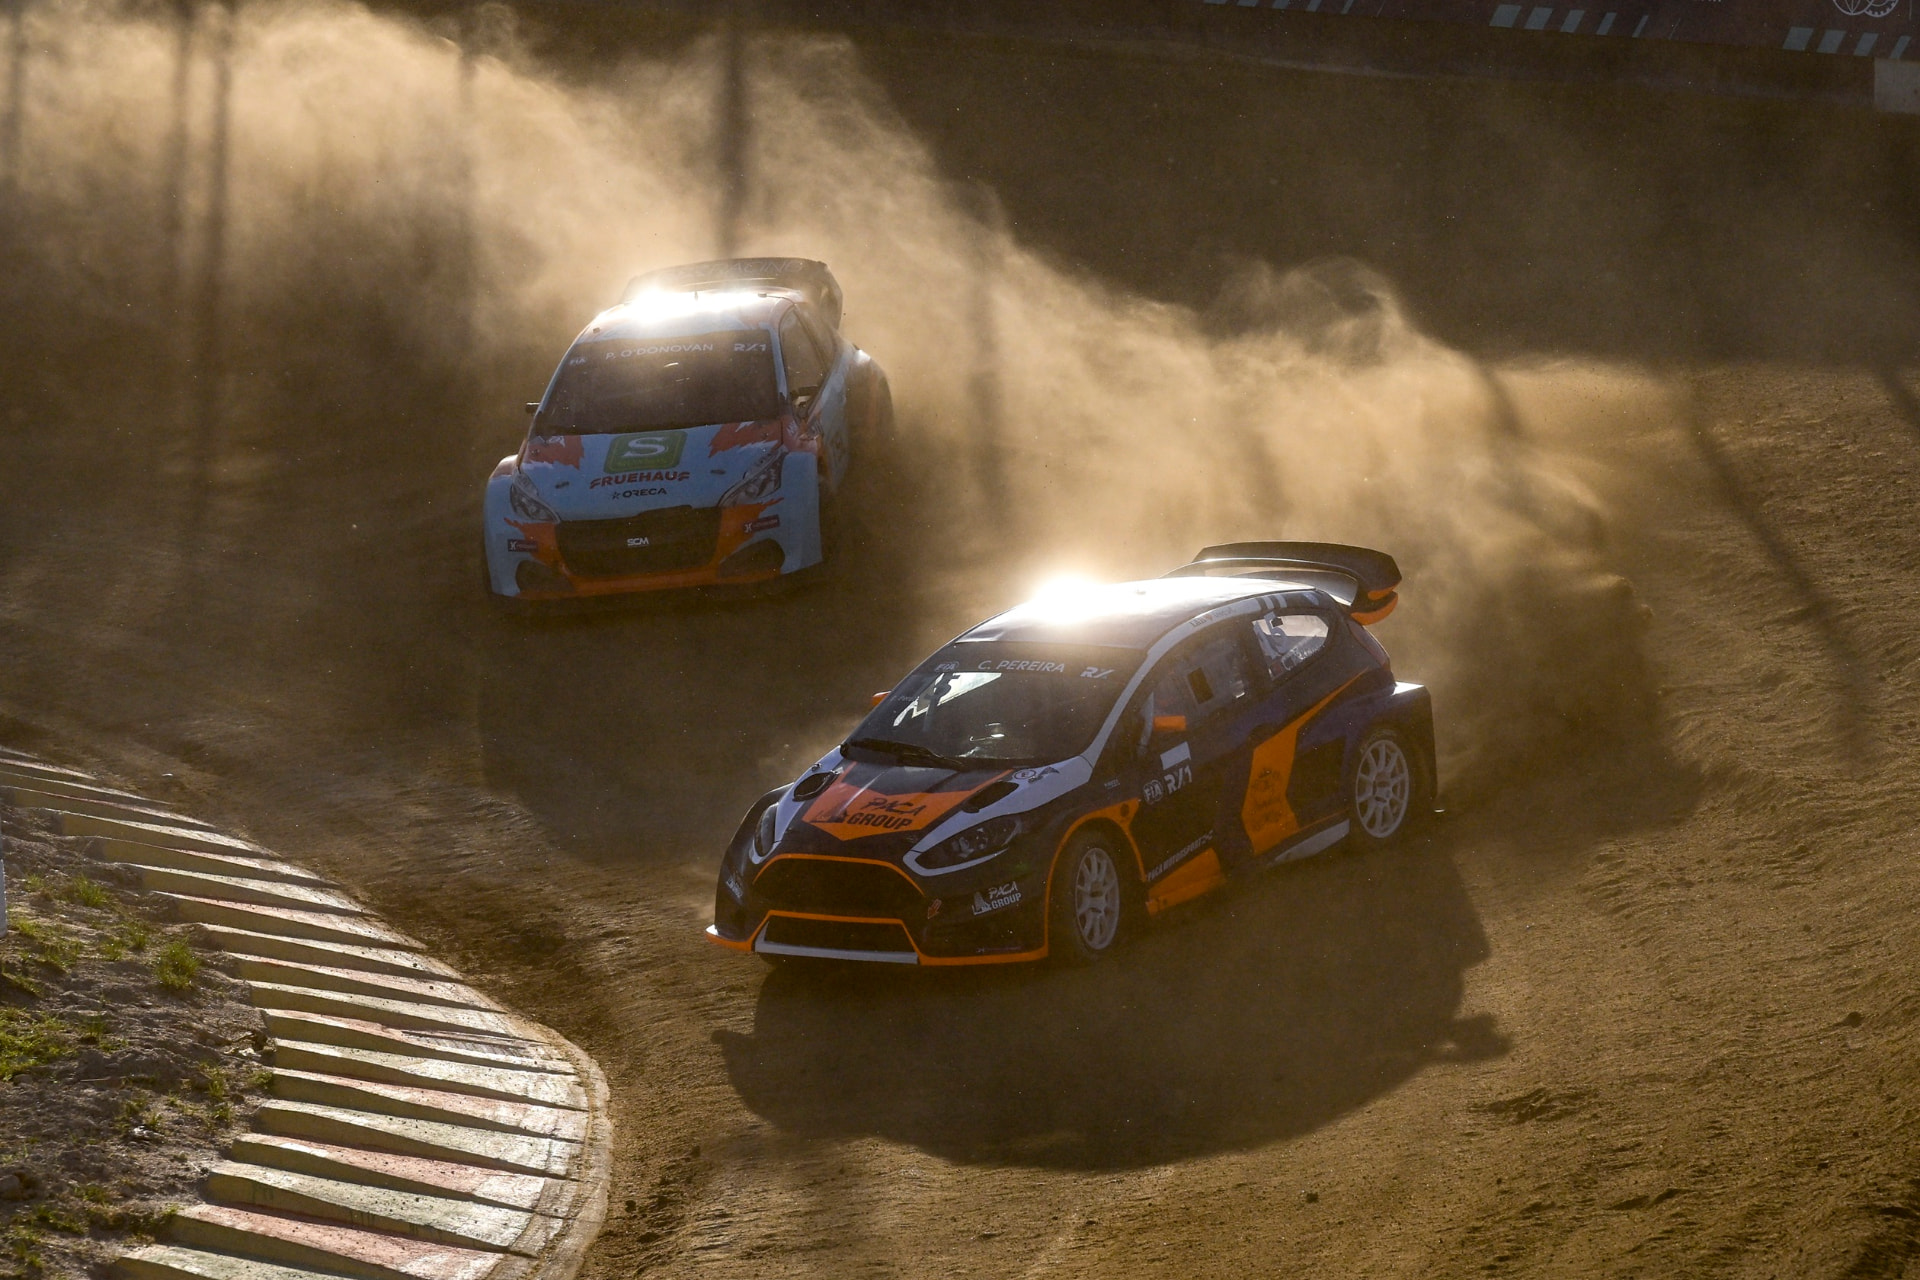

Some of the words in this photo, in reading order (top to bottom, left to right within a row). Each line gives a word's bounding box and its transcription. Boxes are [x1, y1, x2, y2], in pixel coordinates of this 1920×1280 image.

[621, 343, 714, 359] O'DONOVAN
[589, 470, 691, 490] FRUEHAUF
[622, 487, 667, 498] ORECA
[996, 661, 1065, 673] PEREIRA
[847, 812, 913, 830] GROUP
[991, 892, 1022, 910] GROUP
